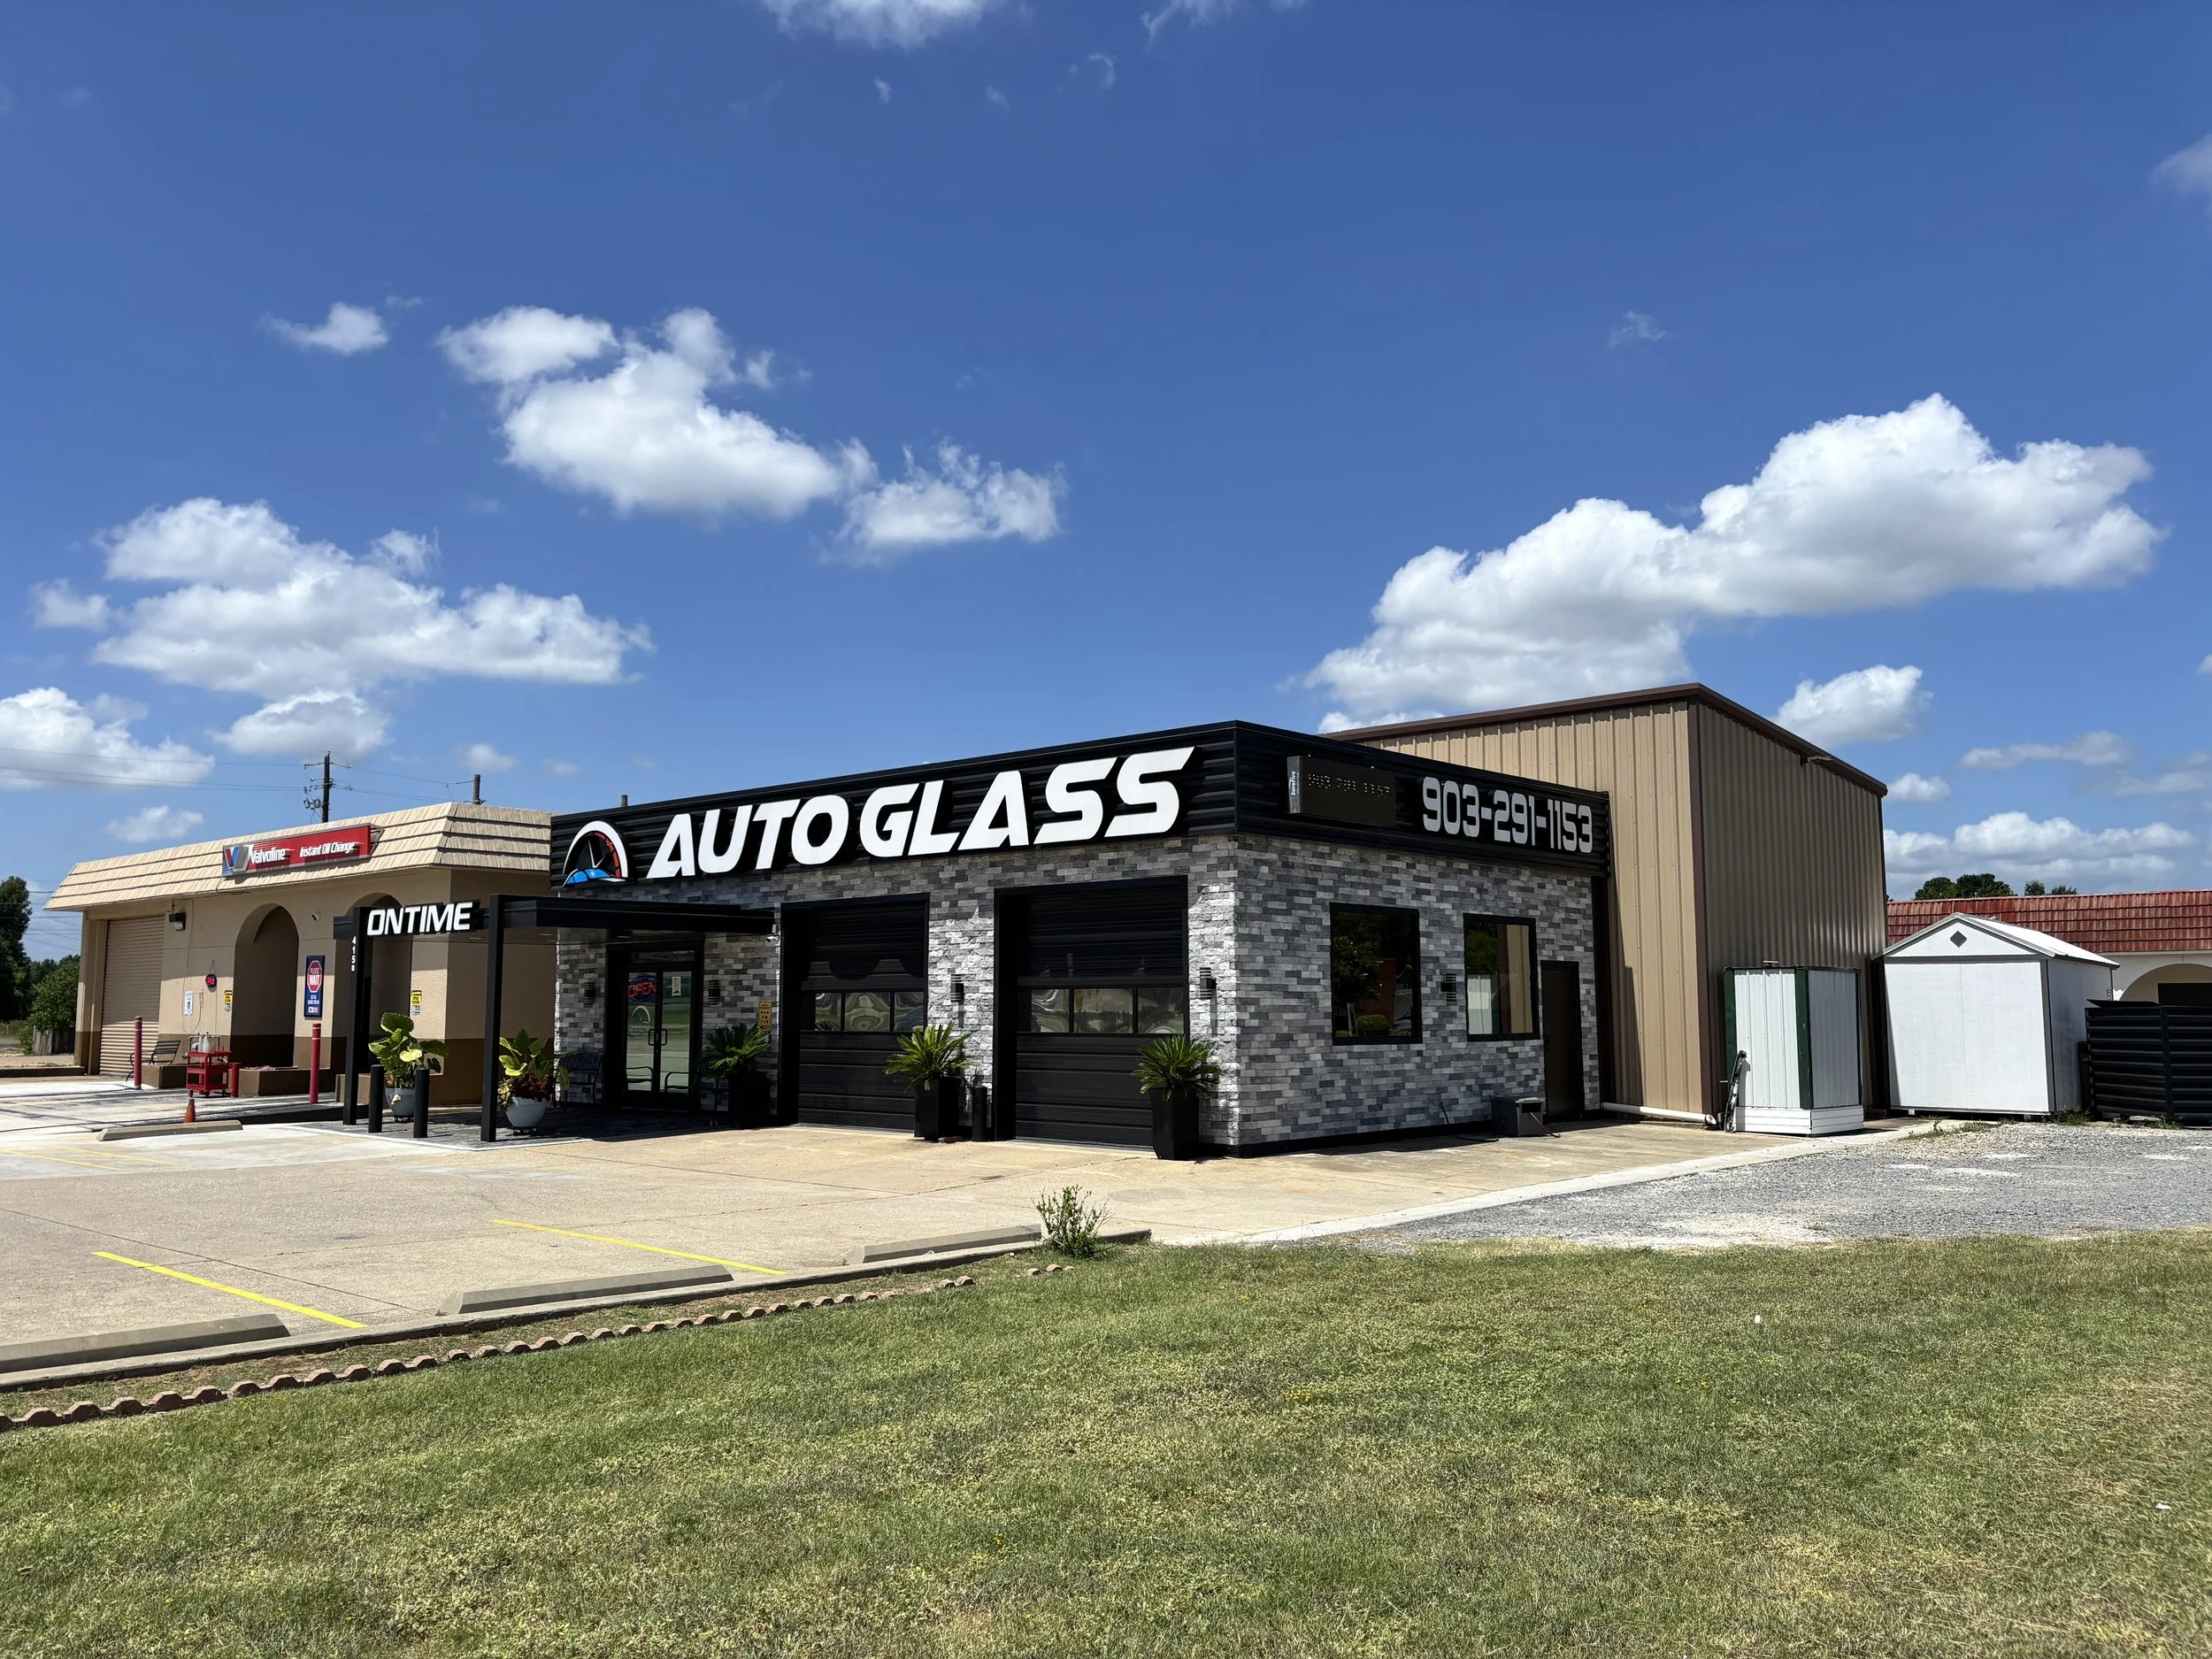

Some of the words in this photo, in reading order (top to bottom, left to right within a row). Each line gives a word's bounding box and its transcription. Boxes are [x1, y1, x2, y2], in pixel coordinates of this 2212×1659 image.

[1423, 776, 1593, 854] 903-291-1153
[242, 844, 287, 864] Valvoline
[299, 845, 321, 857] Instant
[331, 841, 356, 855] Change
[366, 902, 473, 936] ONTIME
[309, 974, 320, 985] WAIT
[627, 981, 657, 997] OPEN
